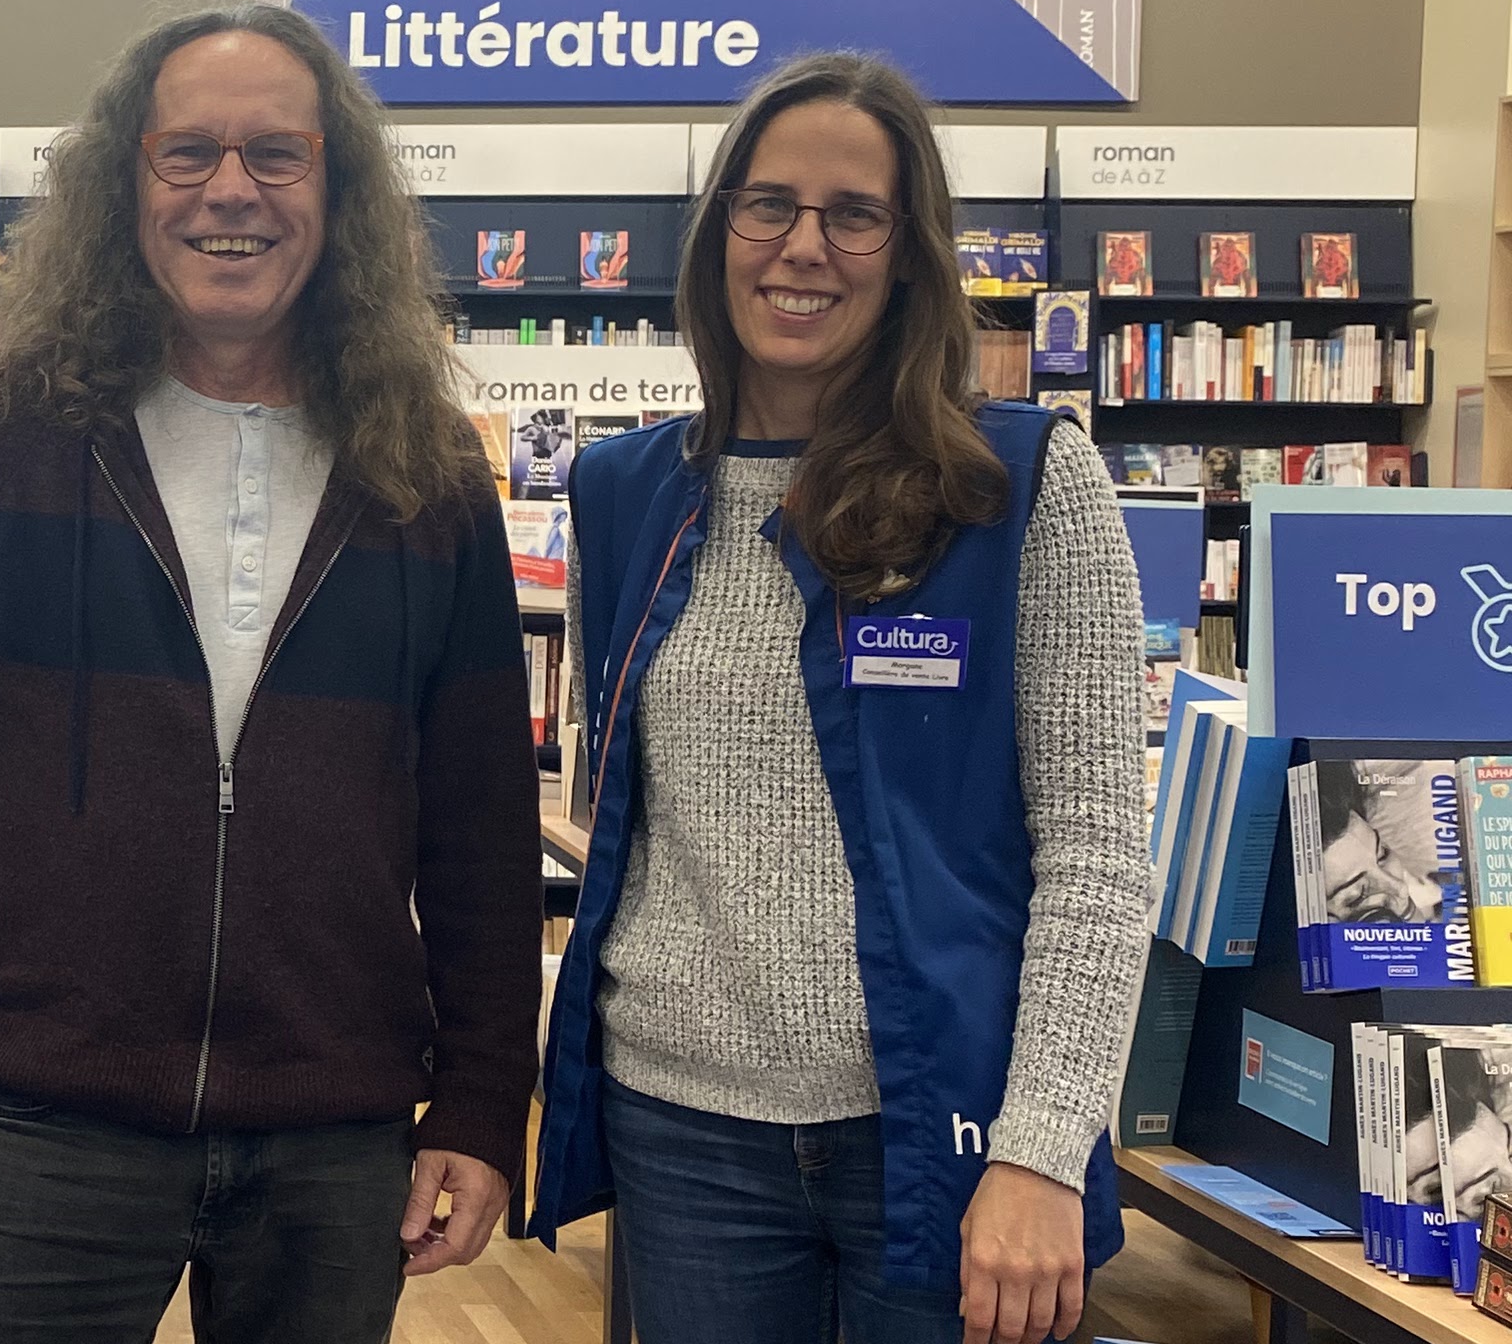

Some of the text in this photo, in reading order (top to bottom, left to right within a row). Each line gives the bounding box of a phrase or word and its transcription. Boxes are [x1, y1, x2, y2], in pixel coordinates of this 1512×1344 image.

[349, 1, 760, 68] Littérature
[1093, 146, 1175, 162] roman
[436, 167, 447, 182] Z
[1091, 169, 1166, 184] de A à Z
[475, 382, 578, 401] roman
[589, 377, 628, 402] de
[1336, 573, 1437, 631] Top
[856, 625, 959, 656] Cultura
[1358, 774, 1371, 785] La
[1482, 817, 1495, 833] LE
[1484, 835, 1499, 851] DU
[1486, 854, 1506, 870] QUI
[1343, 926, 1433, 942] NOUVEAUTÉ
[1484, 1062, 1498, 1075] La
